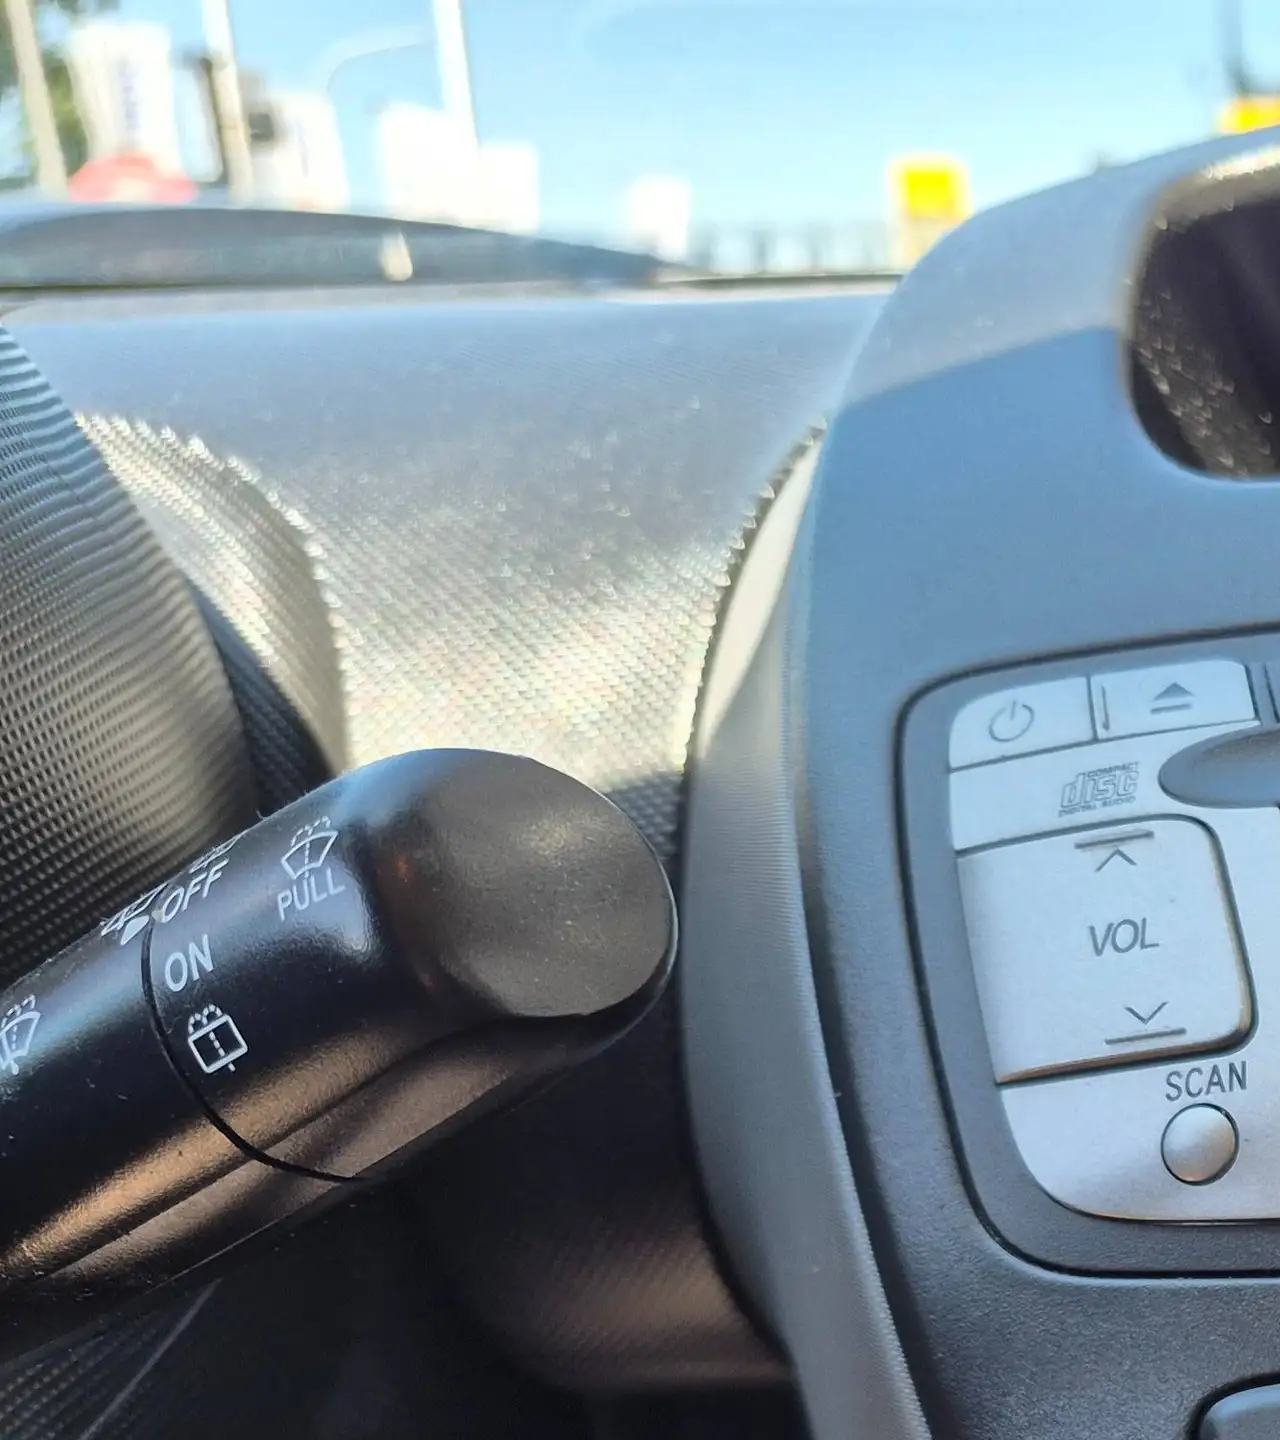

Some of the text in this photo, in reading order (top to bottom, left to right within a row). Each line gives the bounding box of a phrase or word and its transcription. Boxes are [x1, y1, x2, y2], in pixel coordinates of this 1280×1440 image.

[162, 857, 229, 924] OFF
[277, 866, 346, 922] PULL
[165, 933, 215, 992] ON
[1088, 917, 1160, 957] VOL
[1165, 1060, 1248, 1102] SCAN
